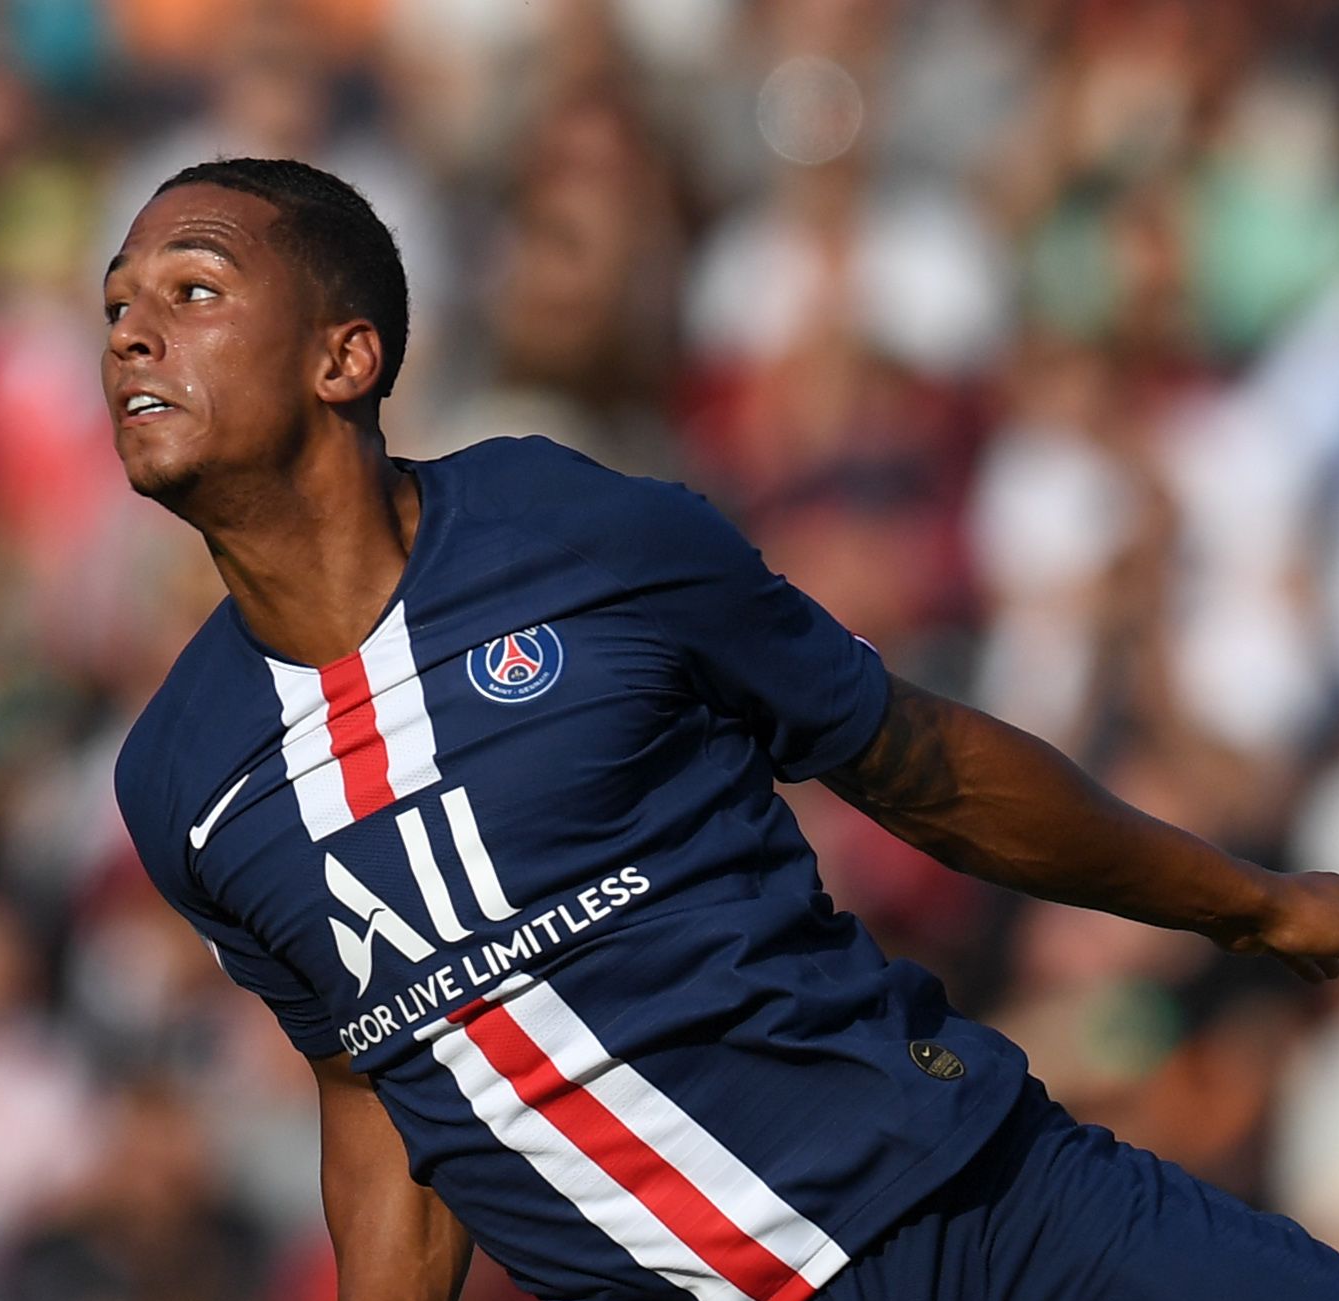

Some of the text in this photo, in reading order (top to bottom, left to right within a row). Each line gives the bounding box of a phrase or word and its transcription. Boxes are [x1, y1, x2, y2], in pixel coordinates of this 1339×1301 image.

[339, 866, 651, 1057] CCOR LIVE LIMITLESS
